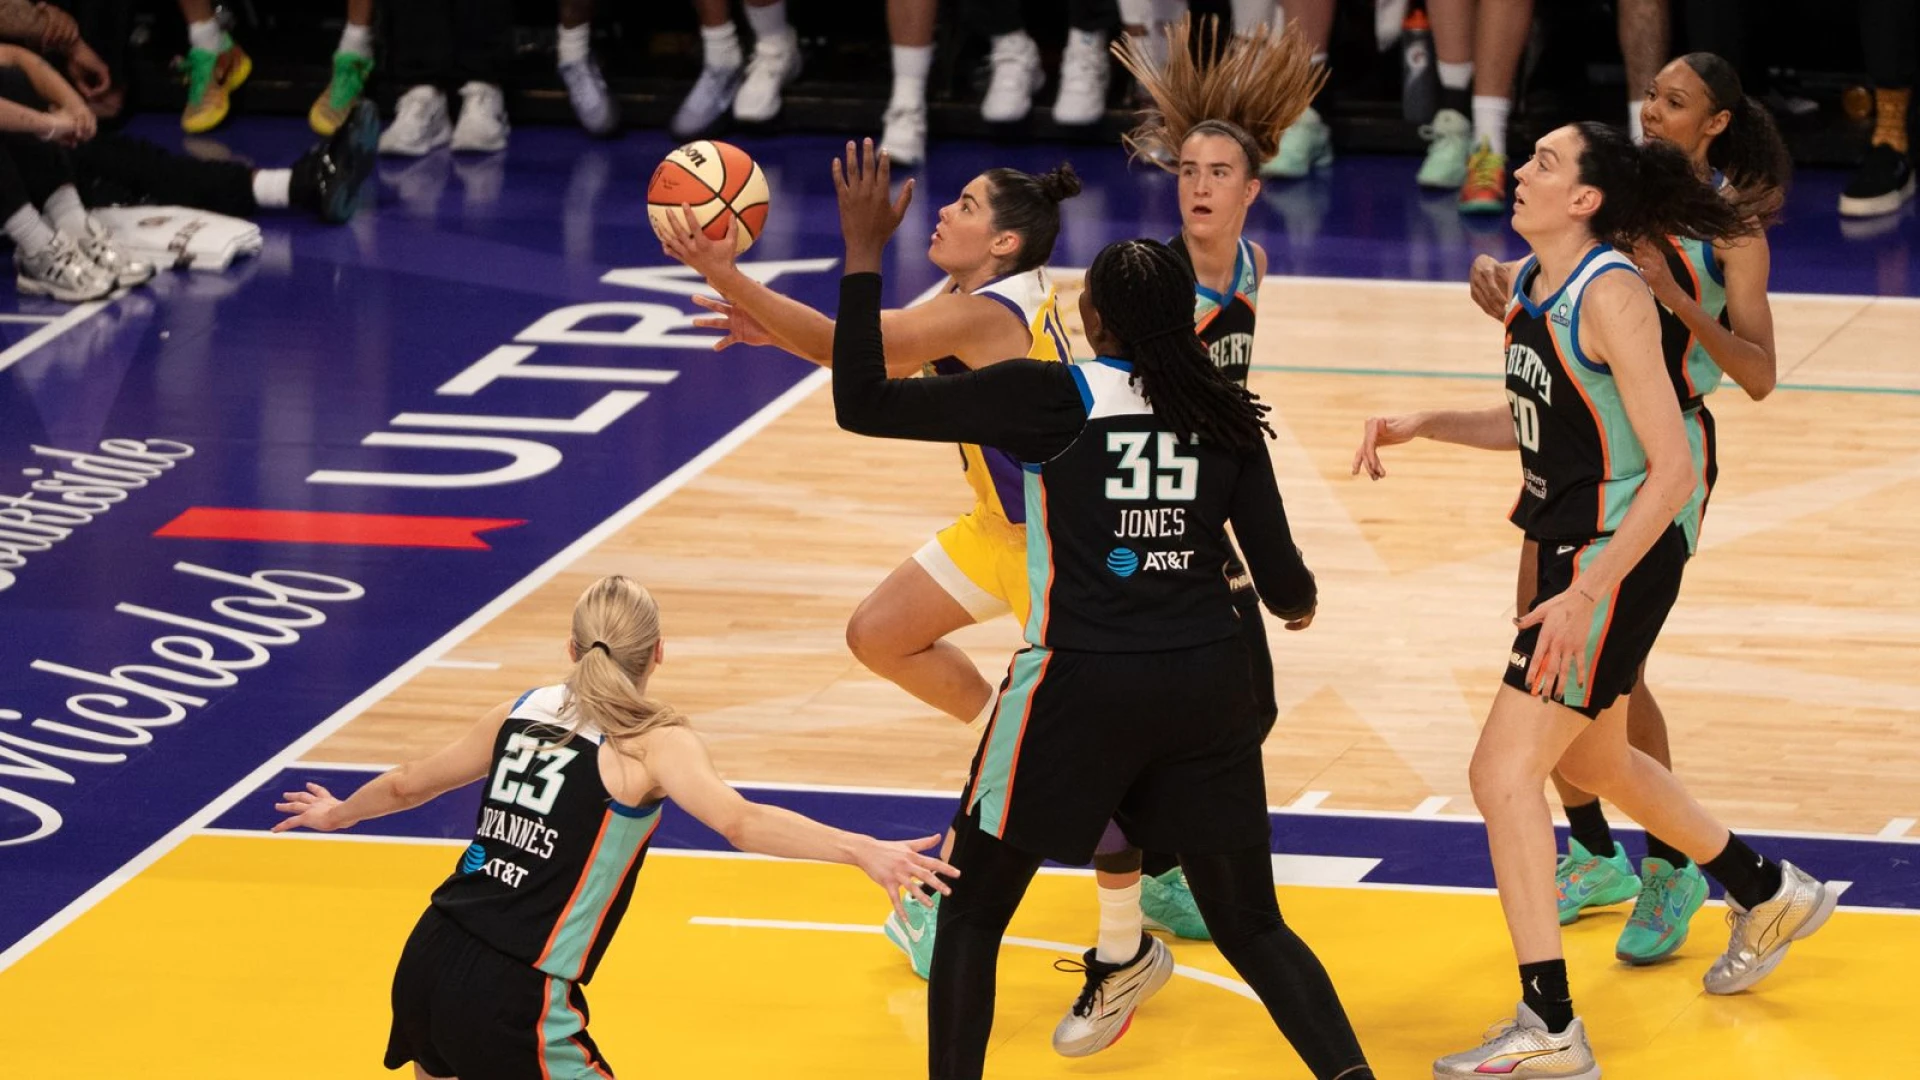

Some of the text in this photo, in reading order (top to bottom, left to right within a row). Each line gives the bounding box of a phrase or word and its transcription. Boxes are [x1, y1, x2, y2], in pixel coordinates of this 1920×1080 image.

[304, 257, 840, 488] ULTRA
[1209, 332, 1254, 368] BERT
[1506, 343, 1553, 407] BERTY
[1105, 431, 1201, 501] 35
[1114, 508, 1187, 538] JONES
[1142, 550, 1195, 571] AT&T
[490, 733, 579, 815] 23
[477, 857, 530, 889] AT&T
